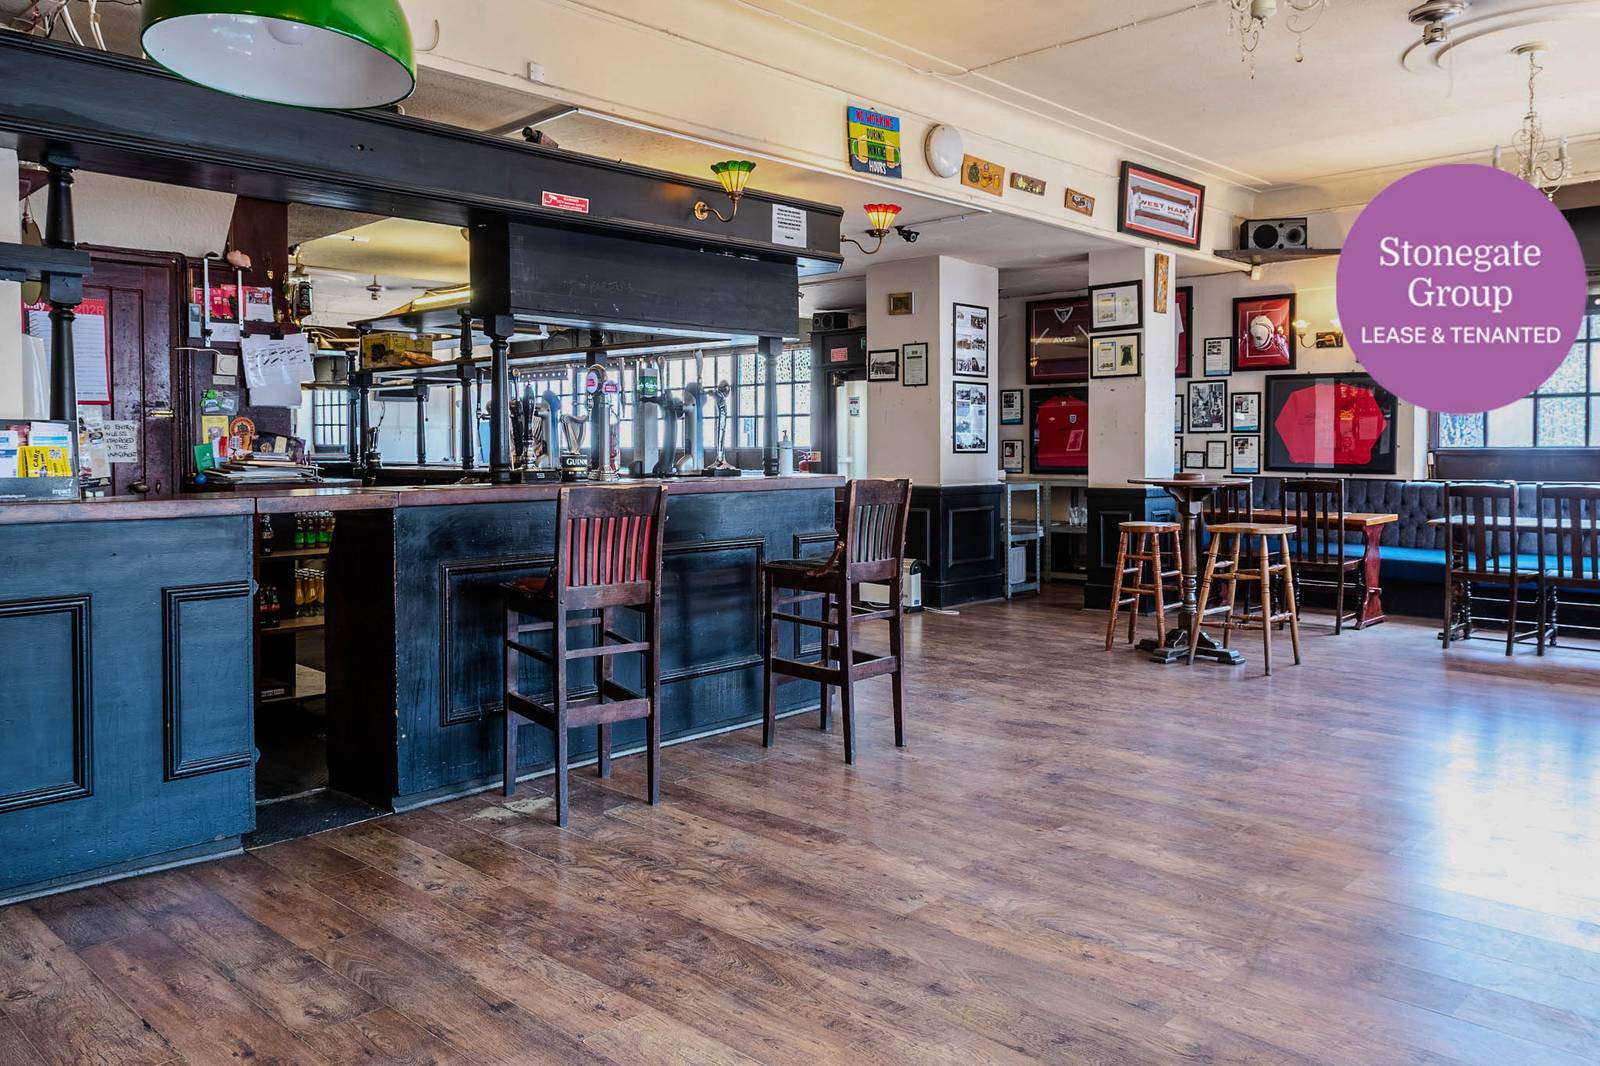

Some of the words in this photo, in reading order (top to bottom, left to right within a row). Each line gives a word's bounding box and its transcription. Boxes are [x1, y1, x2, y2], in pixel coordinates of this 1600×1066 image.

[866, 112, 894, 128] WORKING
[868, 160, 886, 174] HOURS
[1140, 200, 1164, 208] WEST
[33, 449, 41, 468] CARS
[566, 458, 588, 466] GUINN
